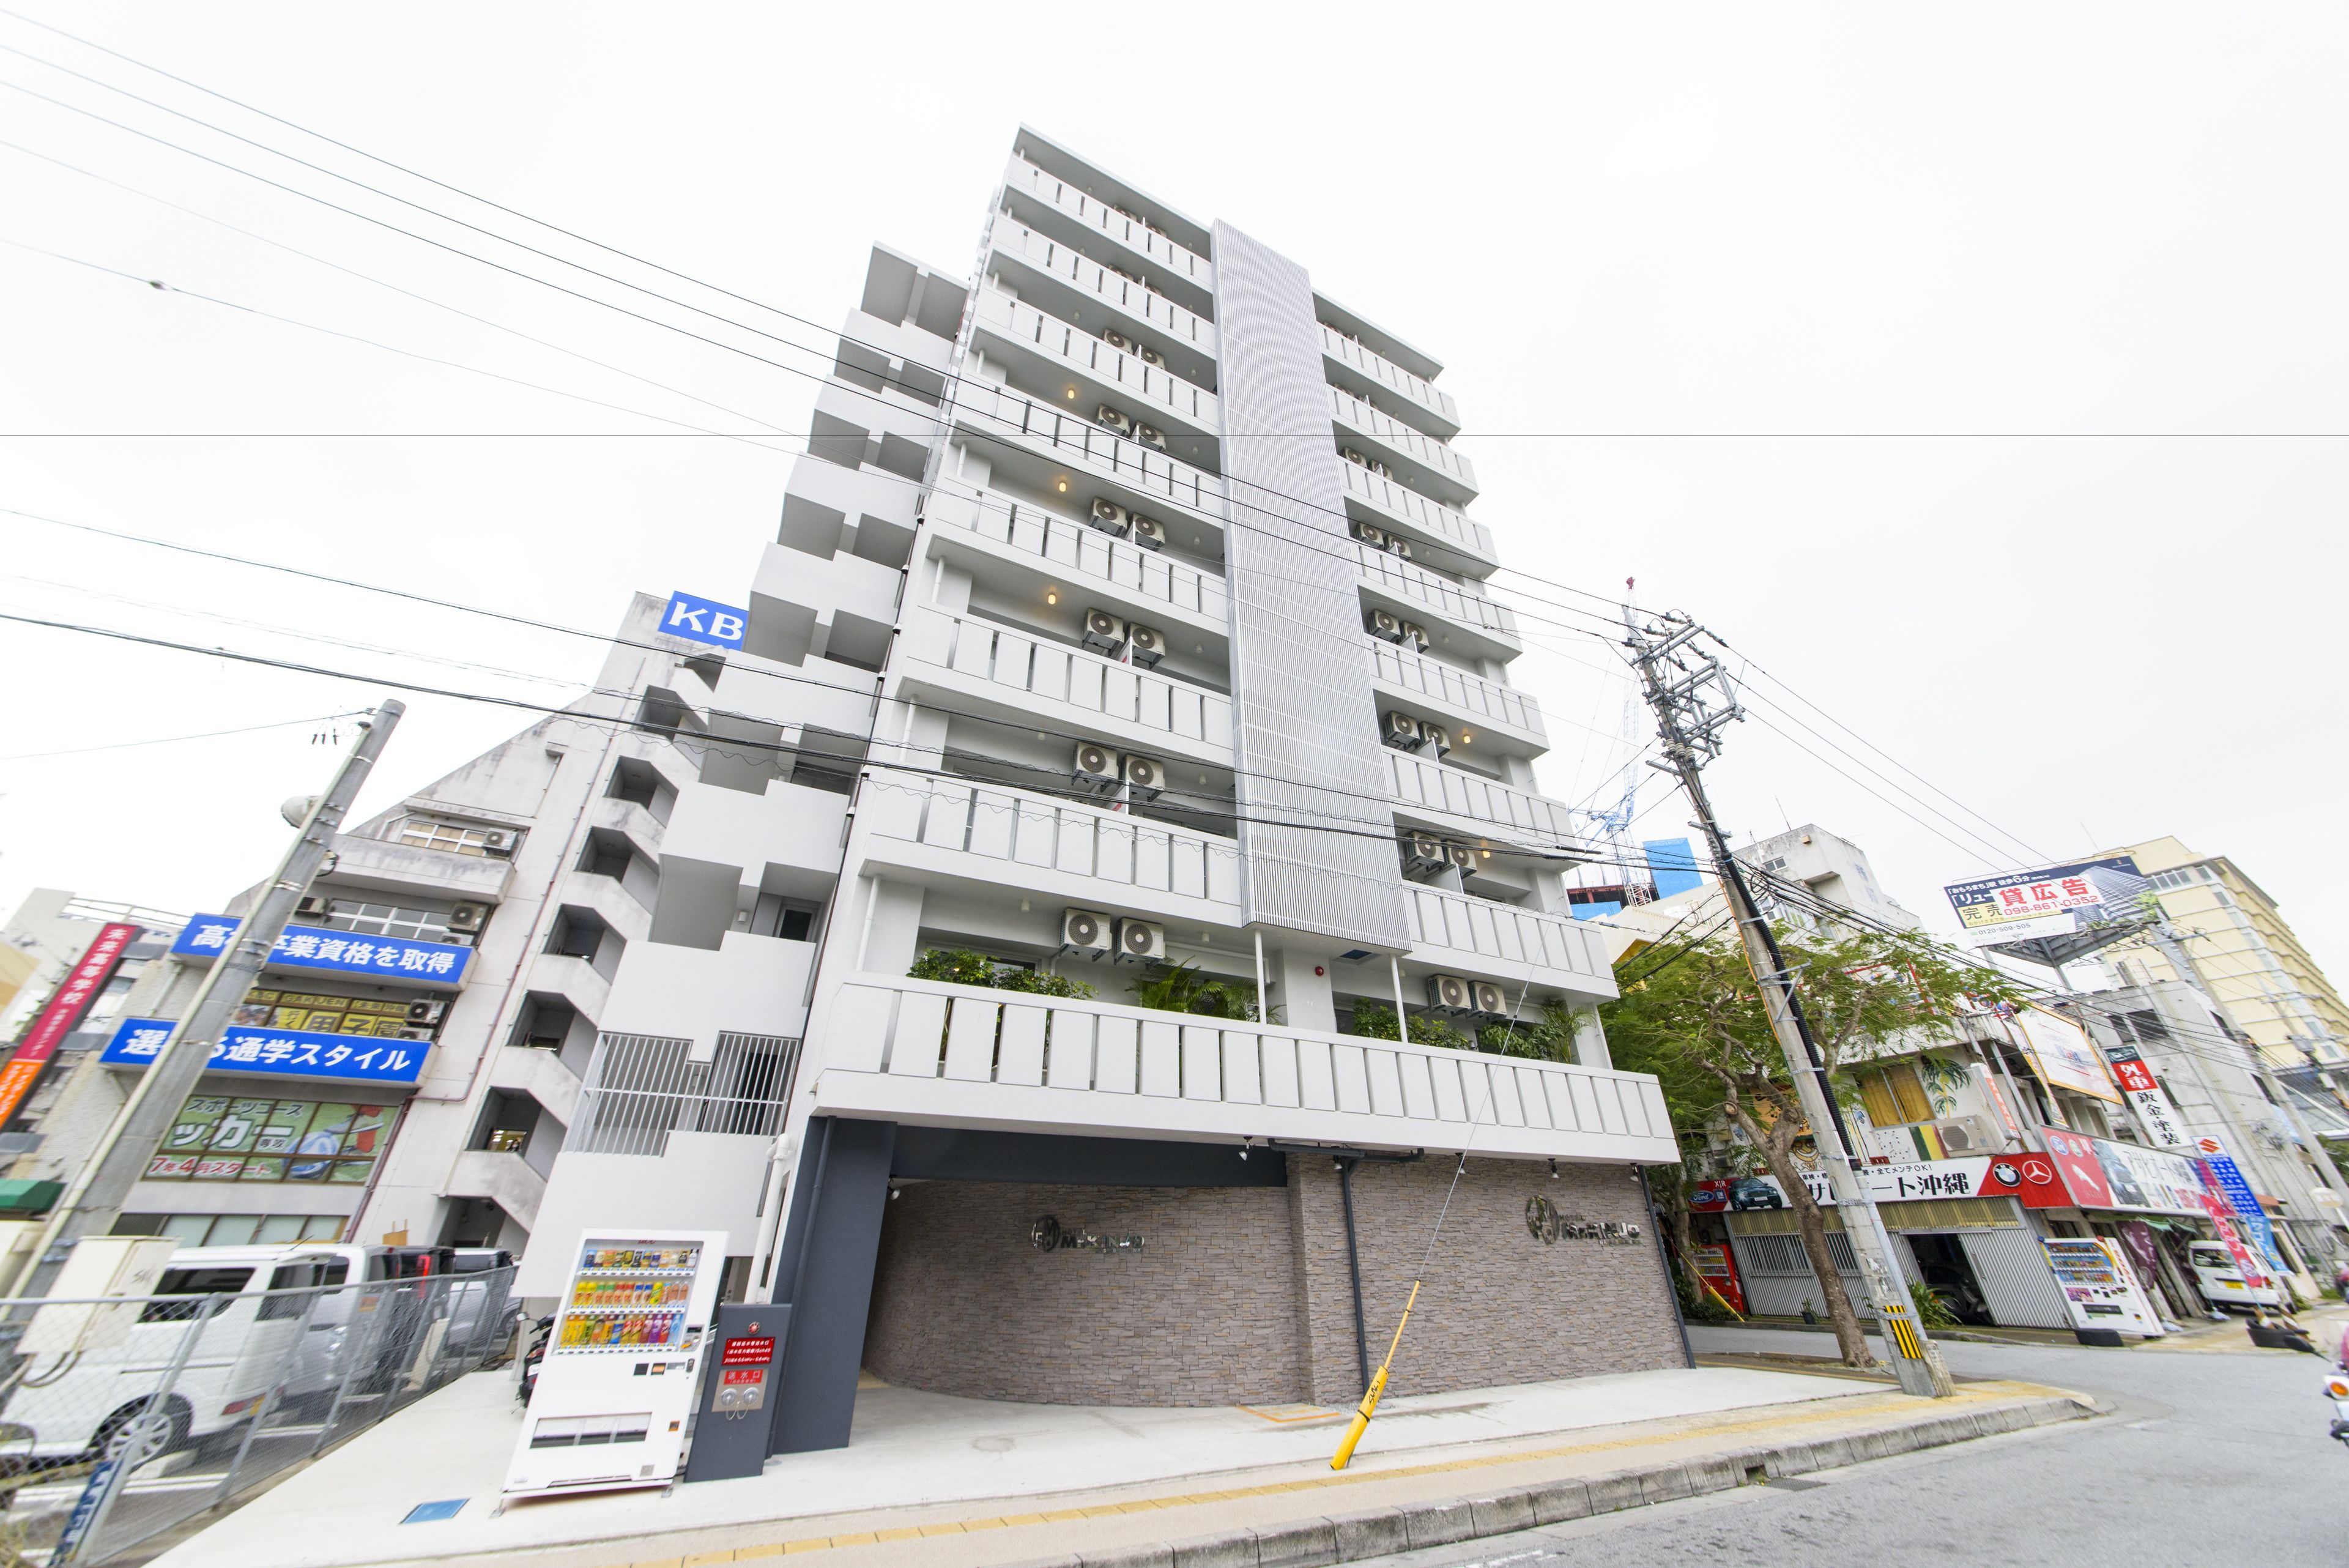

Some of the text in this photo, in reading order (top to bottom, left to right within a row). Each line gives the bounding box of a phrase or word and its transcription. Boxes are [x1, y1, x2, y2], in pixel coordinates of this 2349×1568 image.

[1962, 904, 2002, 921] 完売
[2004, 895, 2099, 916] 098-861-0352
[1978, 923, 2031, 935] 0120-509-505
[191, 924, 456, 974] 高卒業資格を取得
[120, 1028, 411, 1071] 選る通学スタイル
[2119, 1063, 2151, 1089] 外車
[186, 1098, 304, 1117] スポーツコース
[172, 1113, 295, 1148] ッカー
